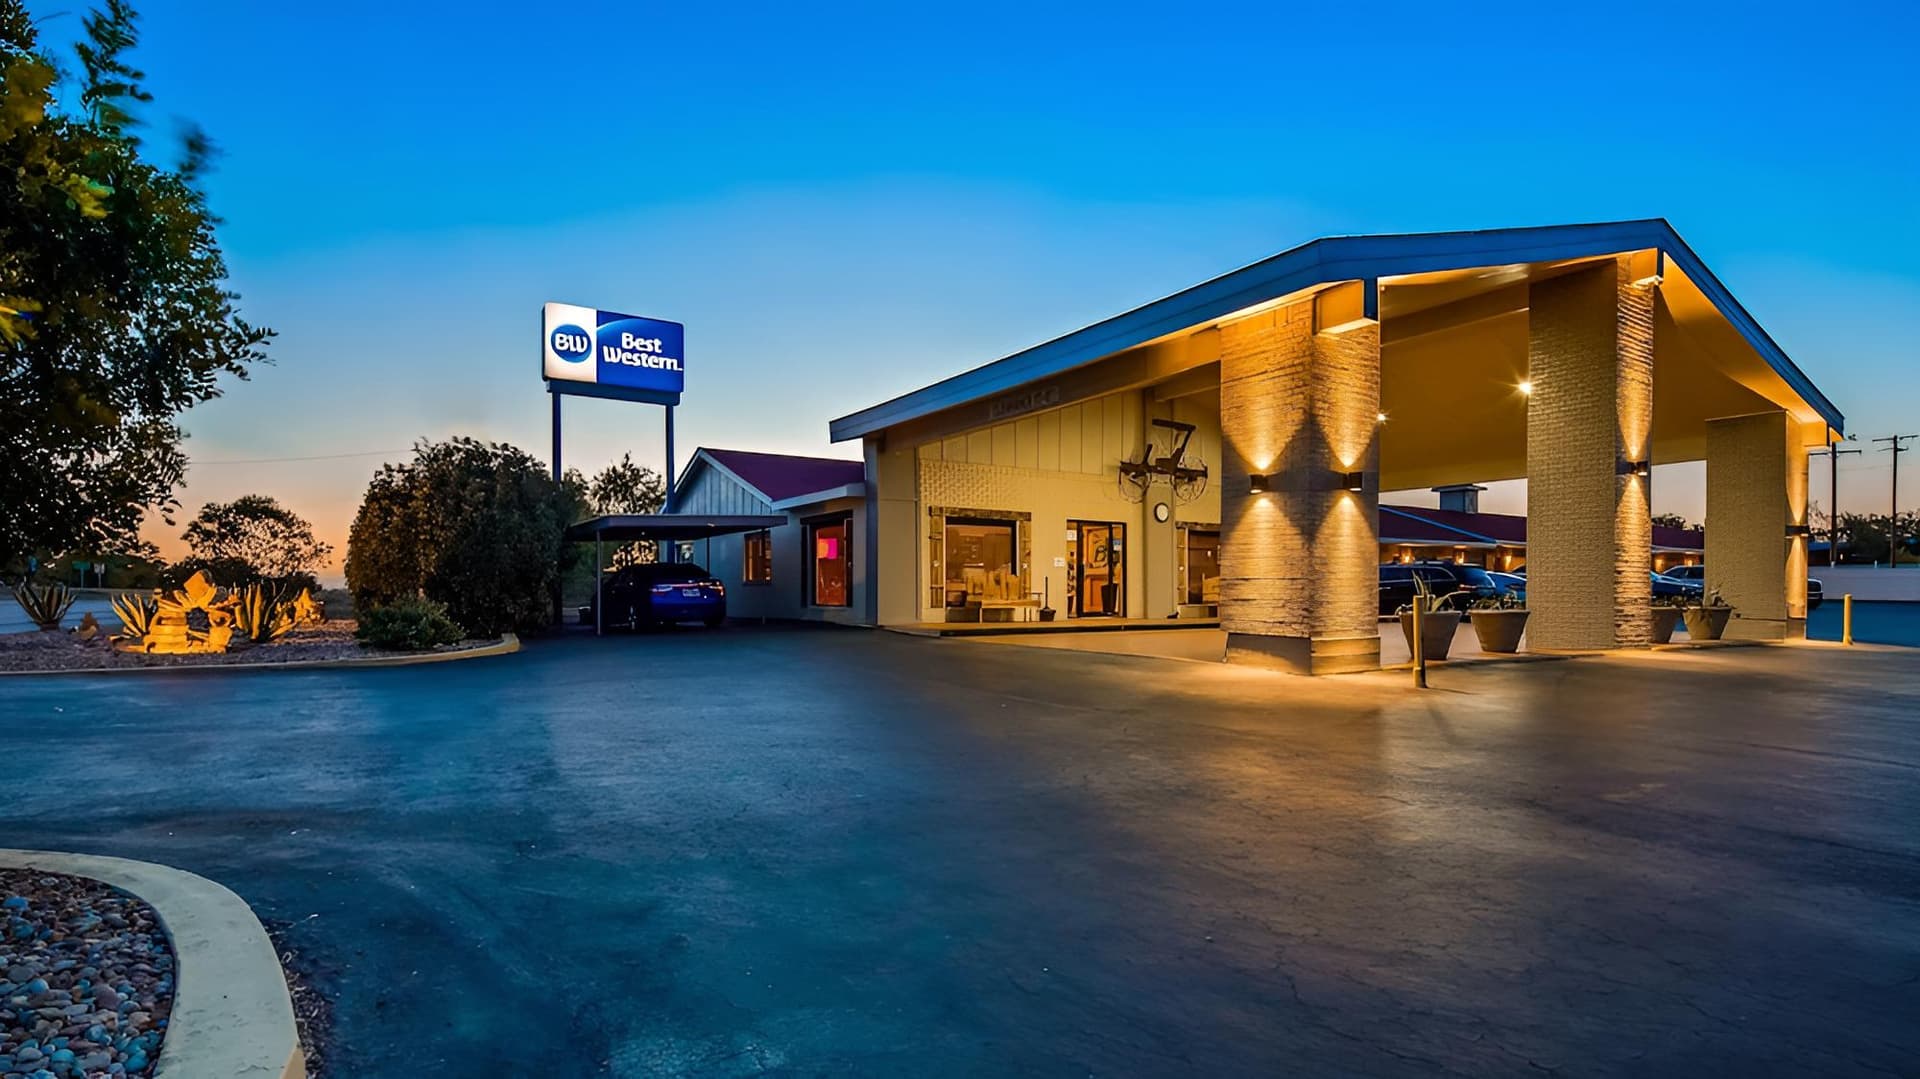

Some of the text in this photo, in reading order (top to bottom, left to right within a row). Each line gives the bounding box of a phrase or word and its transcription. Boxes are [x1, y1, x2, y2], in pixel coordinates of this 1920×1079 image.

[554, 333, 588, 353] BW
[621, 332, 662, 353] Best
[602, 345, 680, 371] Western
